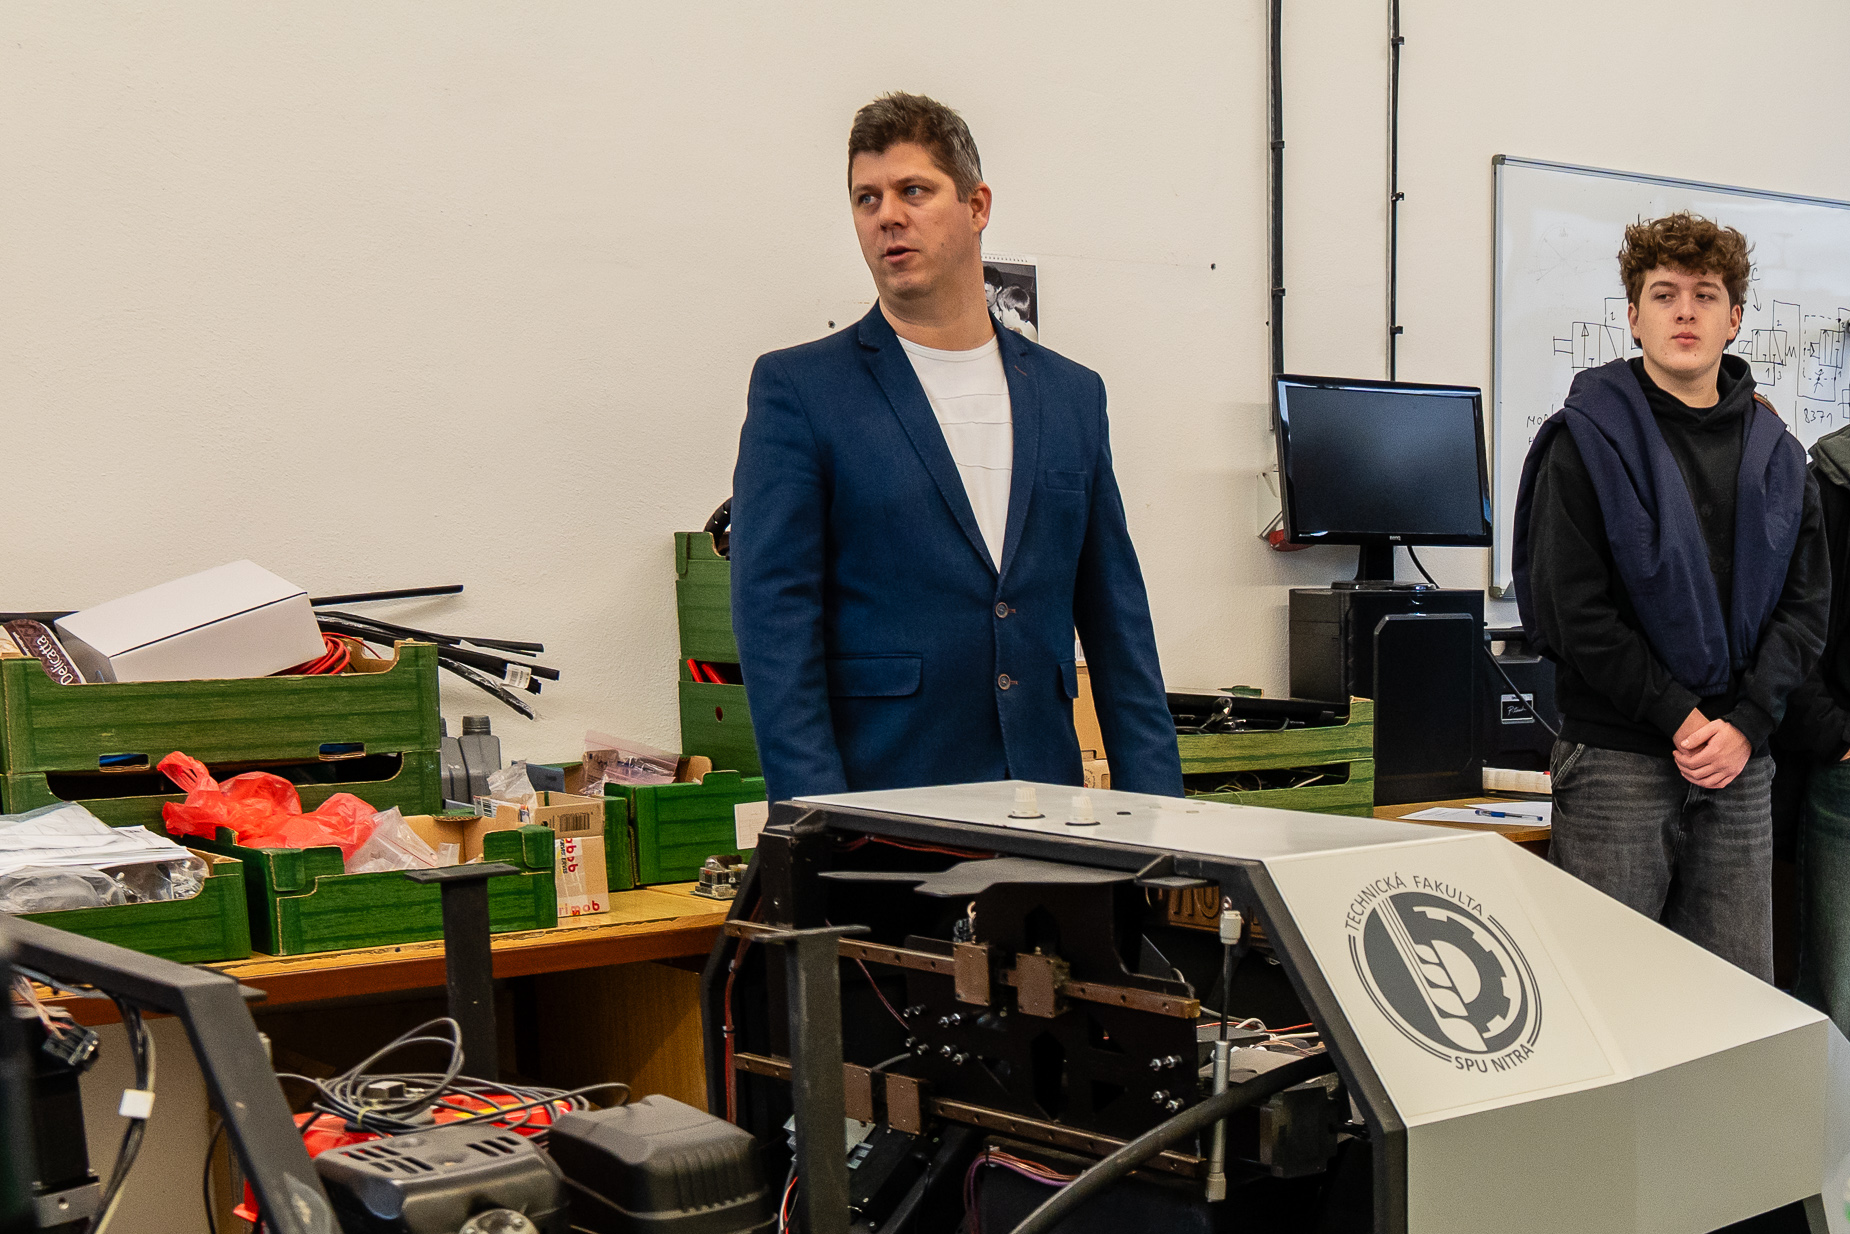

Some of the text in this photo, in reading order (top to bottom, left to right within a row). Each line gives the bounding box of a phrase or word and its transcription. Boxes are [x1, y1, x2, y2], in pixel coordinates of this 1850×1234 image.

[36, 634, 74, 686] Delicatta
[1345, 872, 1484, 931] TECHNICKÁ FAKULTA
[1455, 1043, 1534, 1073] SPU NITRA
